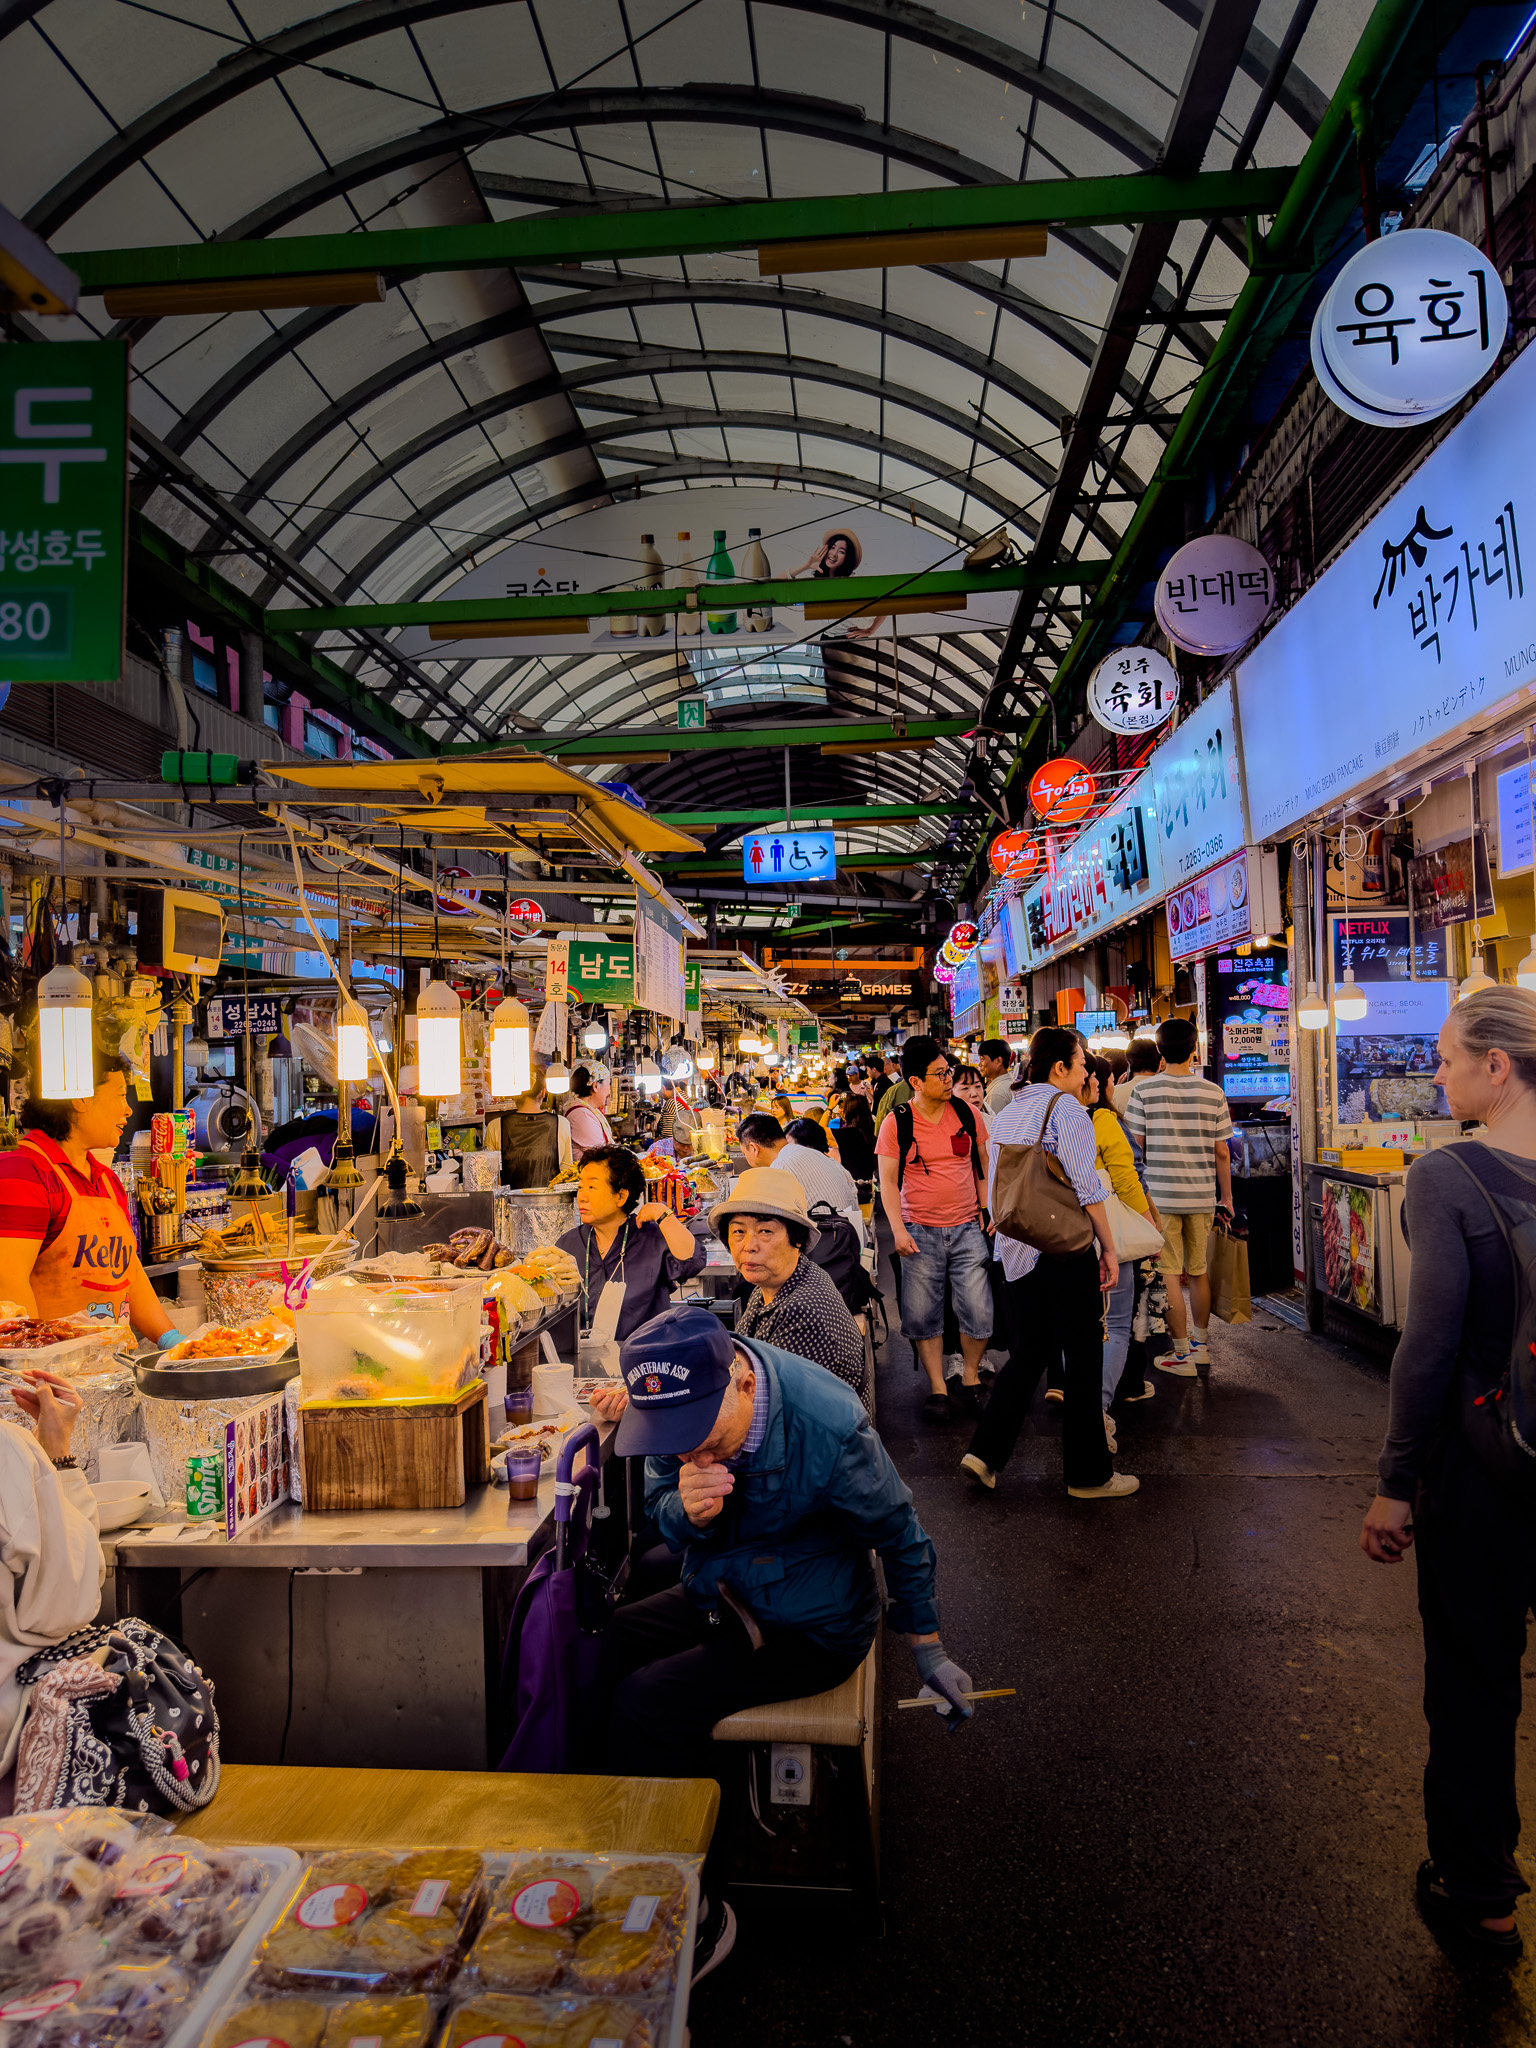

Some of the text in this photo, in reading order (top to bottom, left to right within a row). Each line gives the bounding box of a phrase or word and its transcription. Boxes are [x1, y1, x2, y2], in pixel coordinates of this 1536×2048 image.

[1336, 269, 1490, 366] 육회
[0, 387, 107, 504] 두
[1166, 568, 1269, 613] 빈대떡
[1408, 501, 1524, 664] 박가네
[1117, 657, 1150, 675] 진주
[1104, 680, 1163, 714] 육회
[1122, 714, 1154, 726] (본점)
[1304, 781, 1322, 801] MUNG
[1321, 771, 1337, 791] BEAN
[1337, 753, 1364, 782] PANCAKE
[1179, 834, 1224, 873] T.2263-0366
[1339, 921, 1390, 936] NETFLIX
[1233, 957, 1274, 969] 진주육회
[1361, 946, 1390, 961] 위의
[550, 953, 632, 979] 14 남도
[549, 982, 563, 996] 호
[861, 984, 912, 996] GAMES
[211, 1002, 278, 1023] 14 성남사
[1001, 1000, 1026, 1008] 화장실
[1228, 1027, 1263, 1035] 소머리국밥
[1230, 1036, 1262, 1045] 12,000원
[72, 1234, 132, 1279] Kelly
[196, 1457, 221, 1515] Sprite
